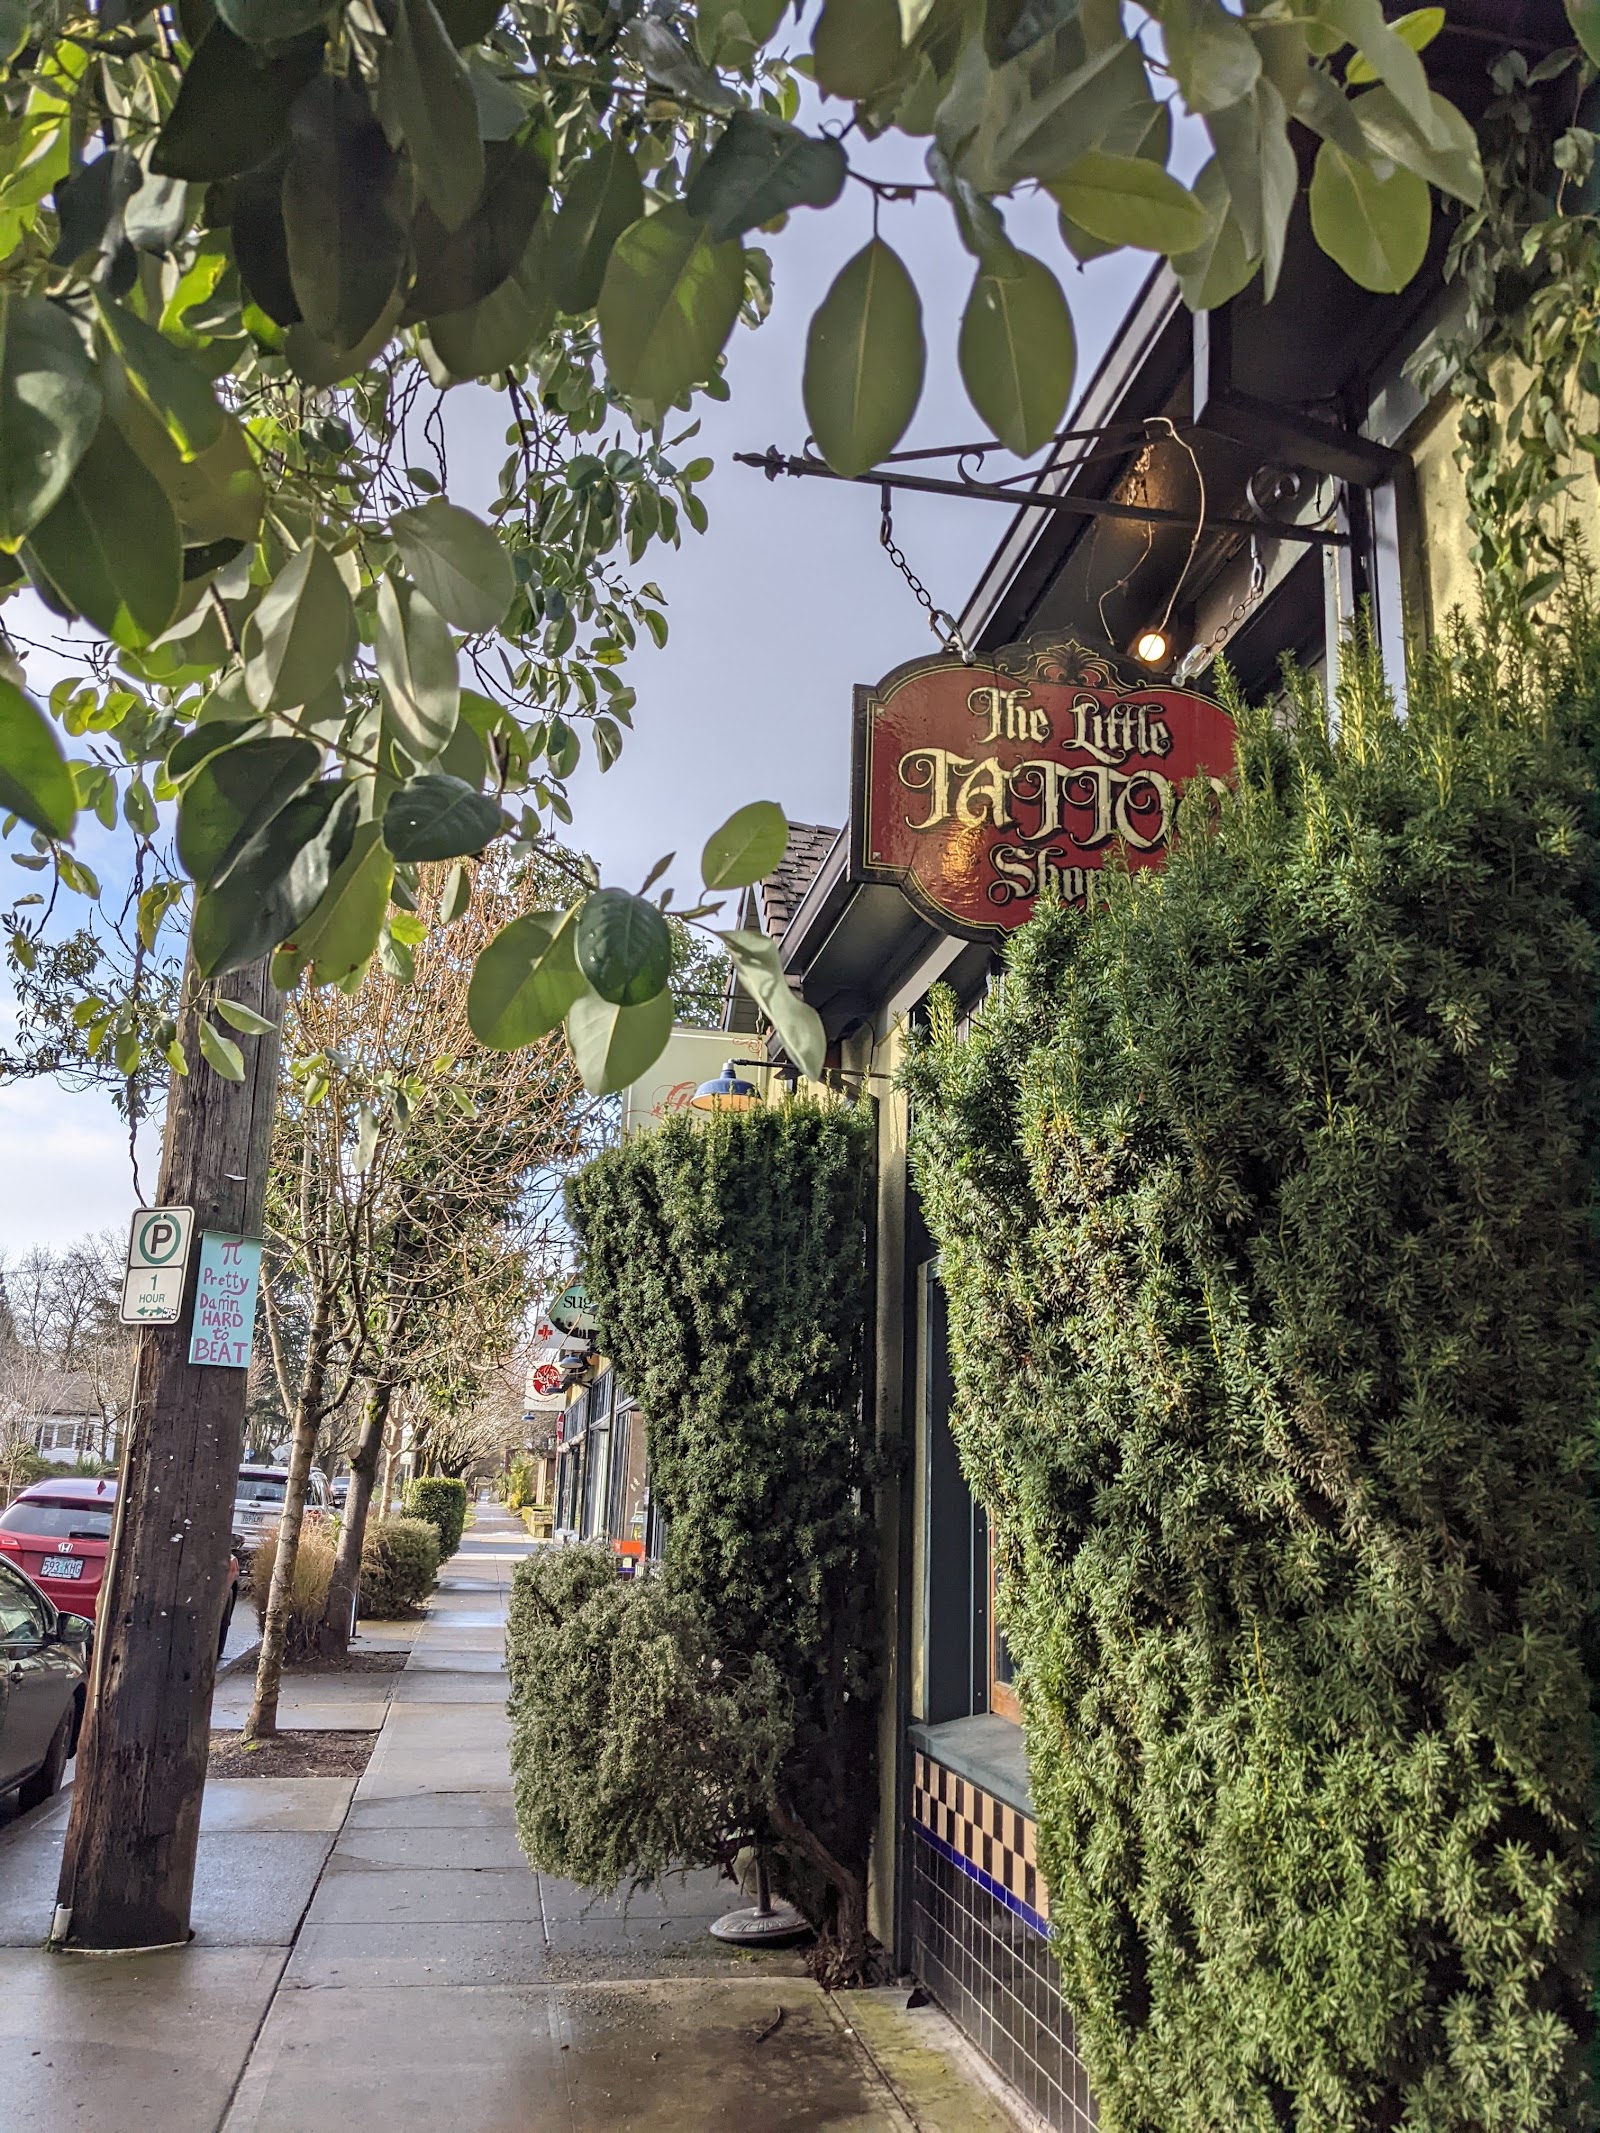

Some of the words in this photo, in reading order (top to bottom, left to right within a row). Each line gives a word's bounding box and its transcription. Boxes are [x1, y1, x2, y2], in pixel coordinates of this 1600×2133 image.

[968, 687, 1050, 743] The
[1062, 693, 1170, 764] Little
[151, 1224, 172, 1254] P
[150, 1274, 158, 1291] 1
[204, 1268, 249, 1296] Pretty
[139, 1294, 165, 1303] HOUR
[200, 1293, 239, 1313] Damn
[202, 1310, 243, 1327] HARD
[212, 1328, 229, 1340] to
[194, 1338, 248, 1364] BEAT
[43, 1561, 60, 1573] 593
[64, 1563, 82, 1575] KHG
